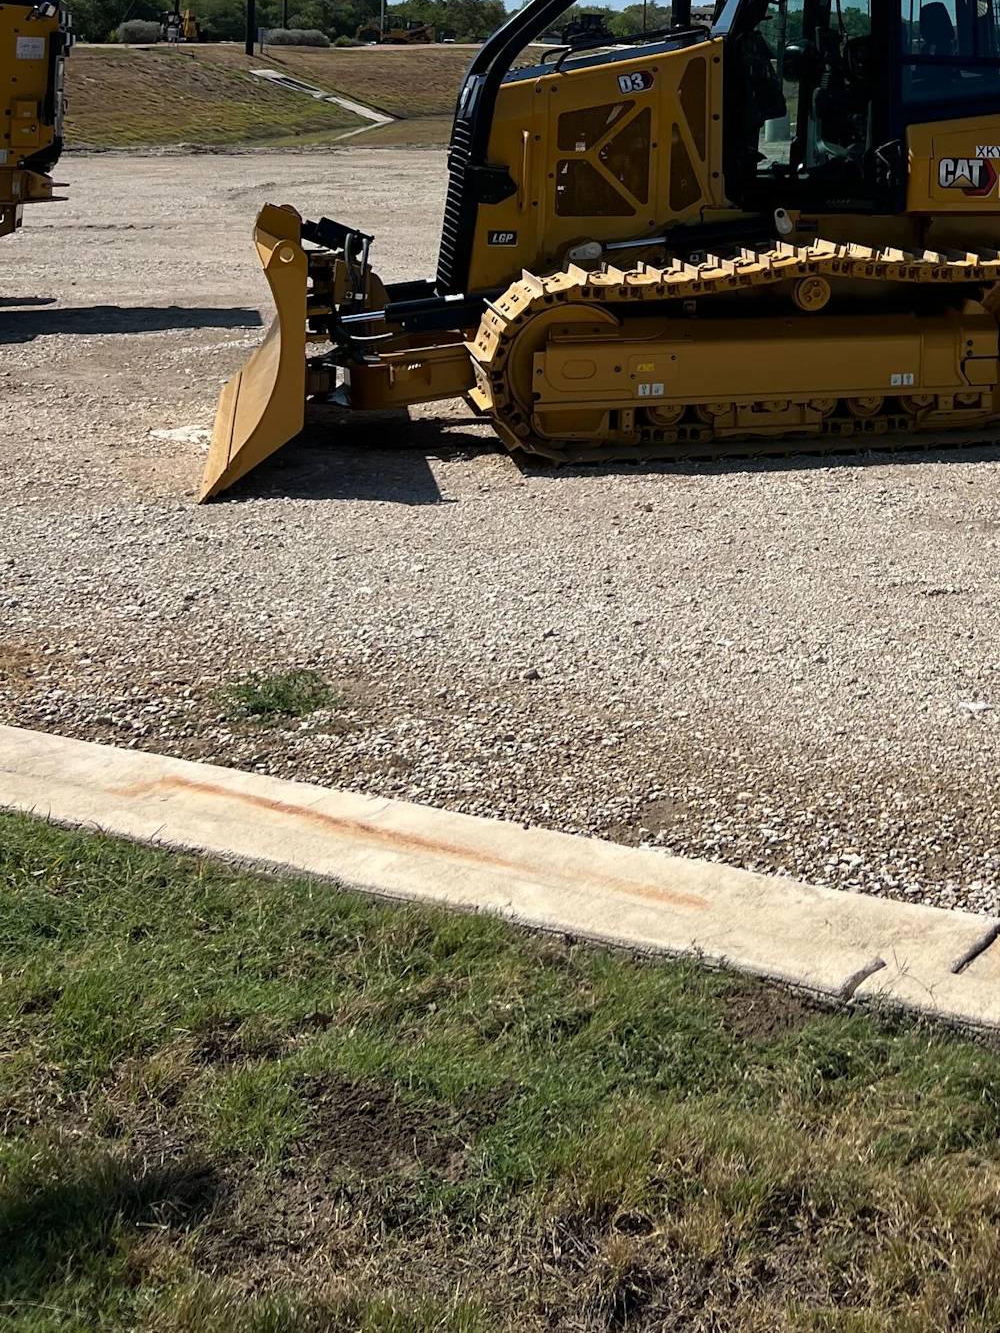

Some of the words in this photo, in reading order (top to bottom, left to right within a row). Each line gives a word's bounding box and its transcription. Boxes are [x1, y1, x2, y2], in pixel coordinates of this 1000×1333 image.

[618, 72, 644, 94] D3
[939, 158, 983, 188] CAT
[492, 233, 514, 243] LGP
